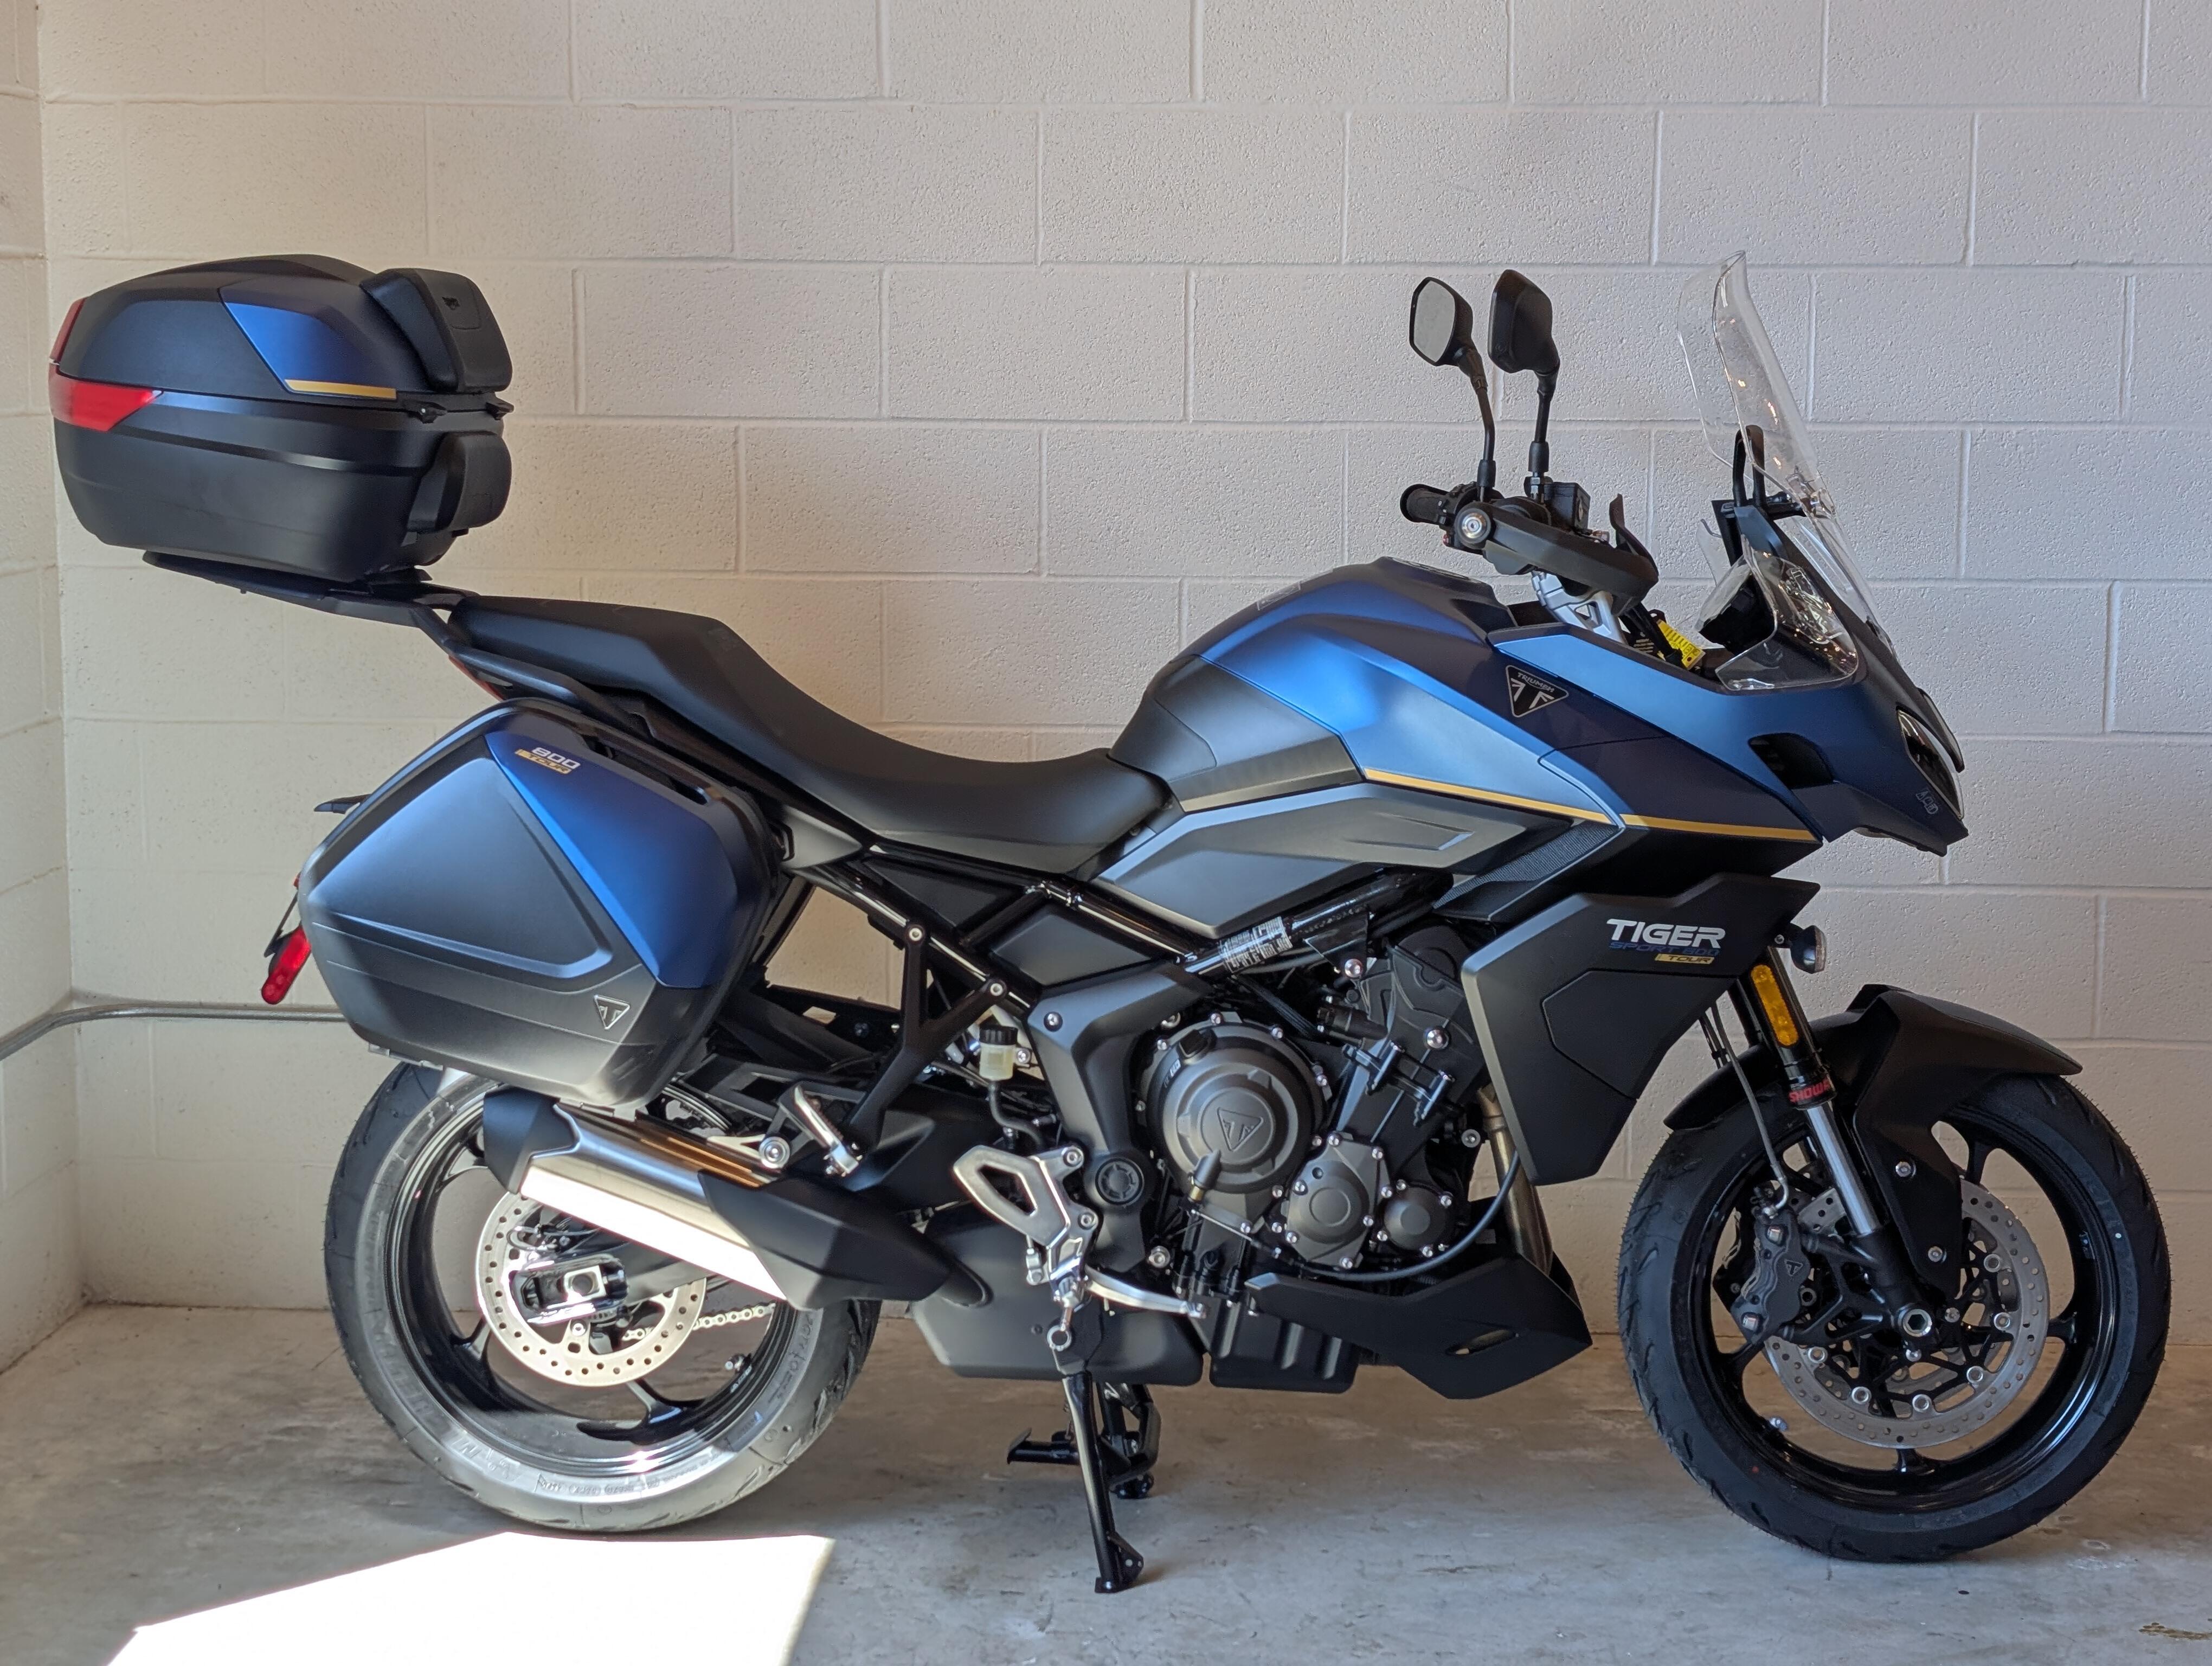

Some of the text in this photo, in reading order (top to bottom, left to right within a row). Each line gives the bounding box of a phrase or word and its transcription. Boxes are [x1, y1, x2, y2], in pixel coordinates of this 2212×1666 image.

[1517, 672, 1554, 693] TRIUMPH
[529, 753, 568, 772] TOUR
[532, 747, 581, 769] 800
[1606, 919, 1726, 948] TIGER
[1609, 941, 1679, 953] SPORT
[1668, 955, 1711, 963] TOUR
